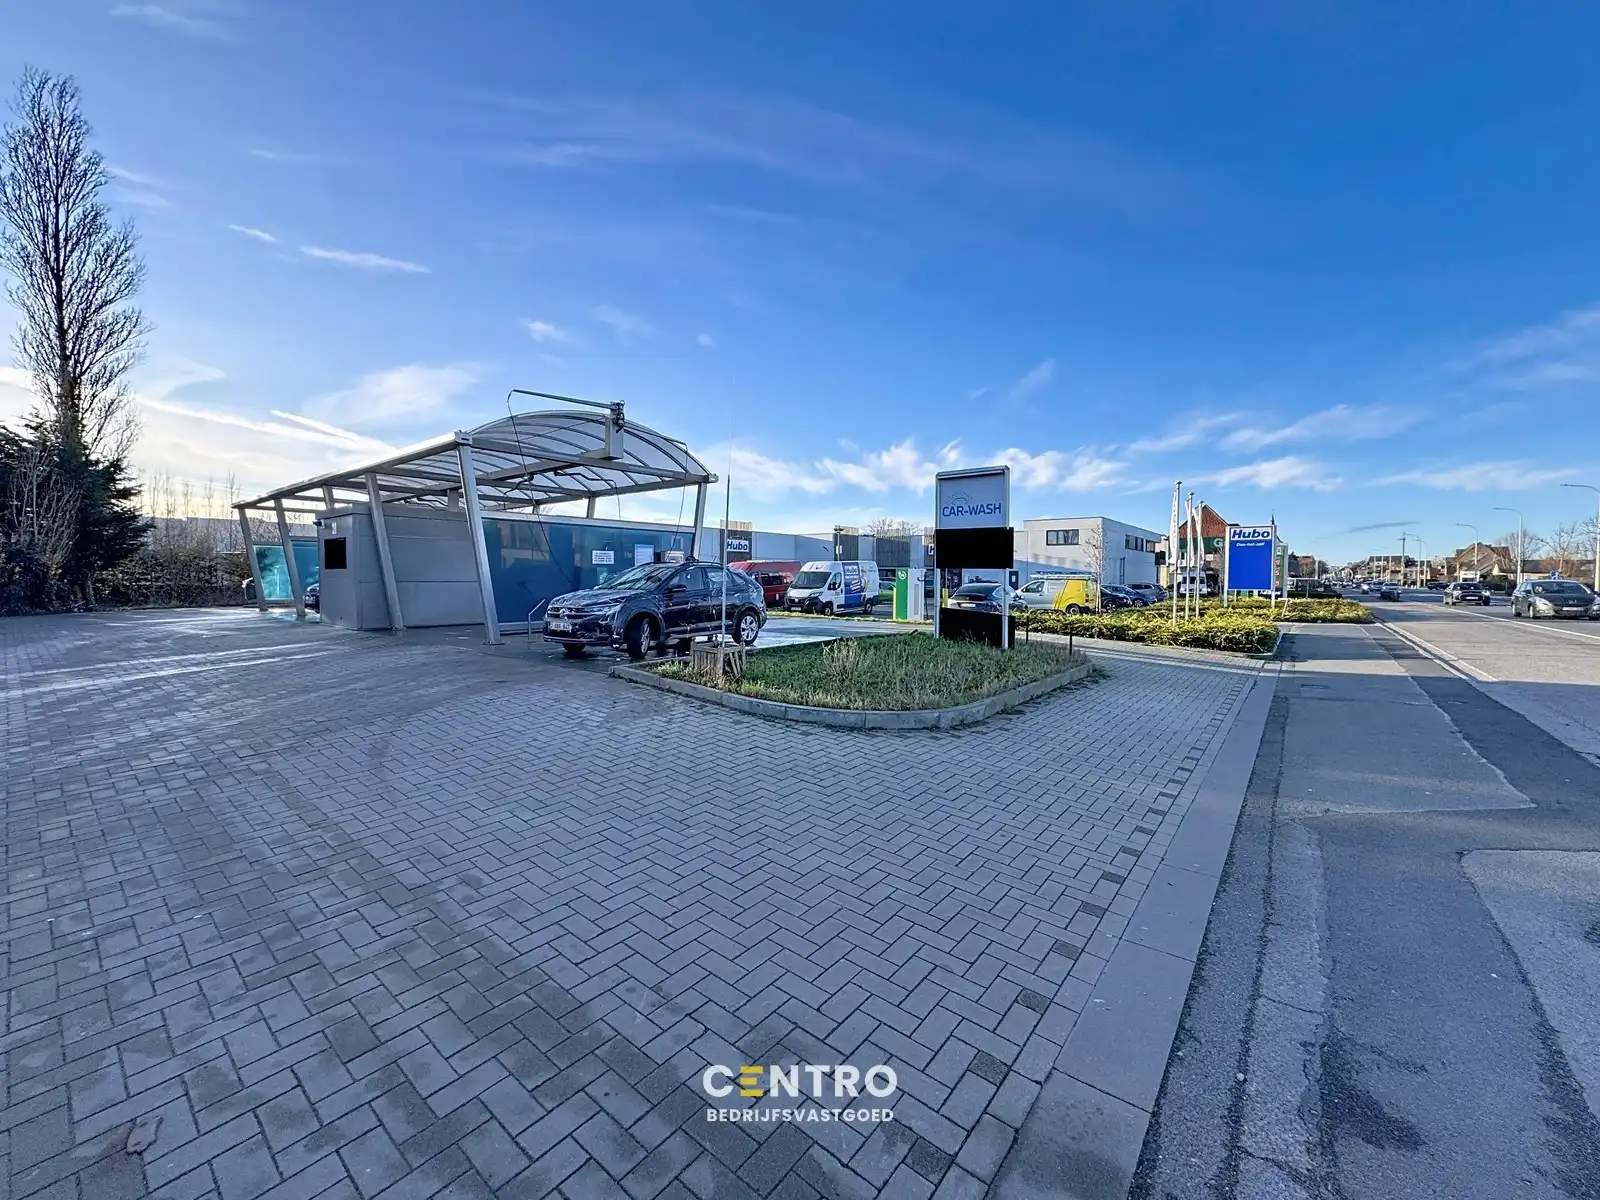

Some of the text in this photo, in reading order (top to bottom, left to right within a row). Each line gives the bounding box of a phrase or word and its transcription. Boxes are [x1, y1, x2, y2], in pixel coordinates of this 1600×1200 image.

[942, 502, 1002, 517] CAR-WASH
[1232, 529, 1270, 539] Hubo
[727, 541, 748, 551] Hubo
